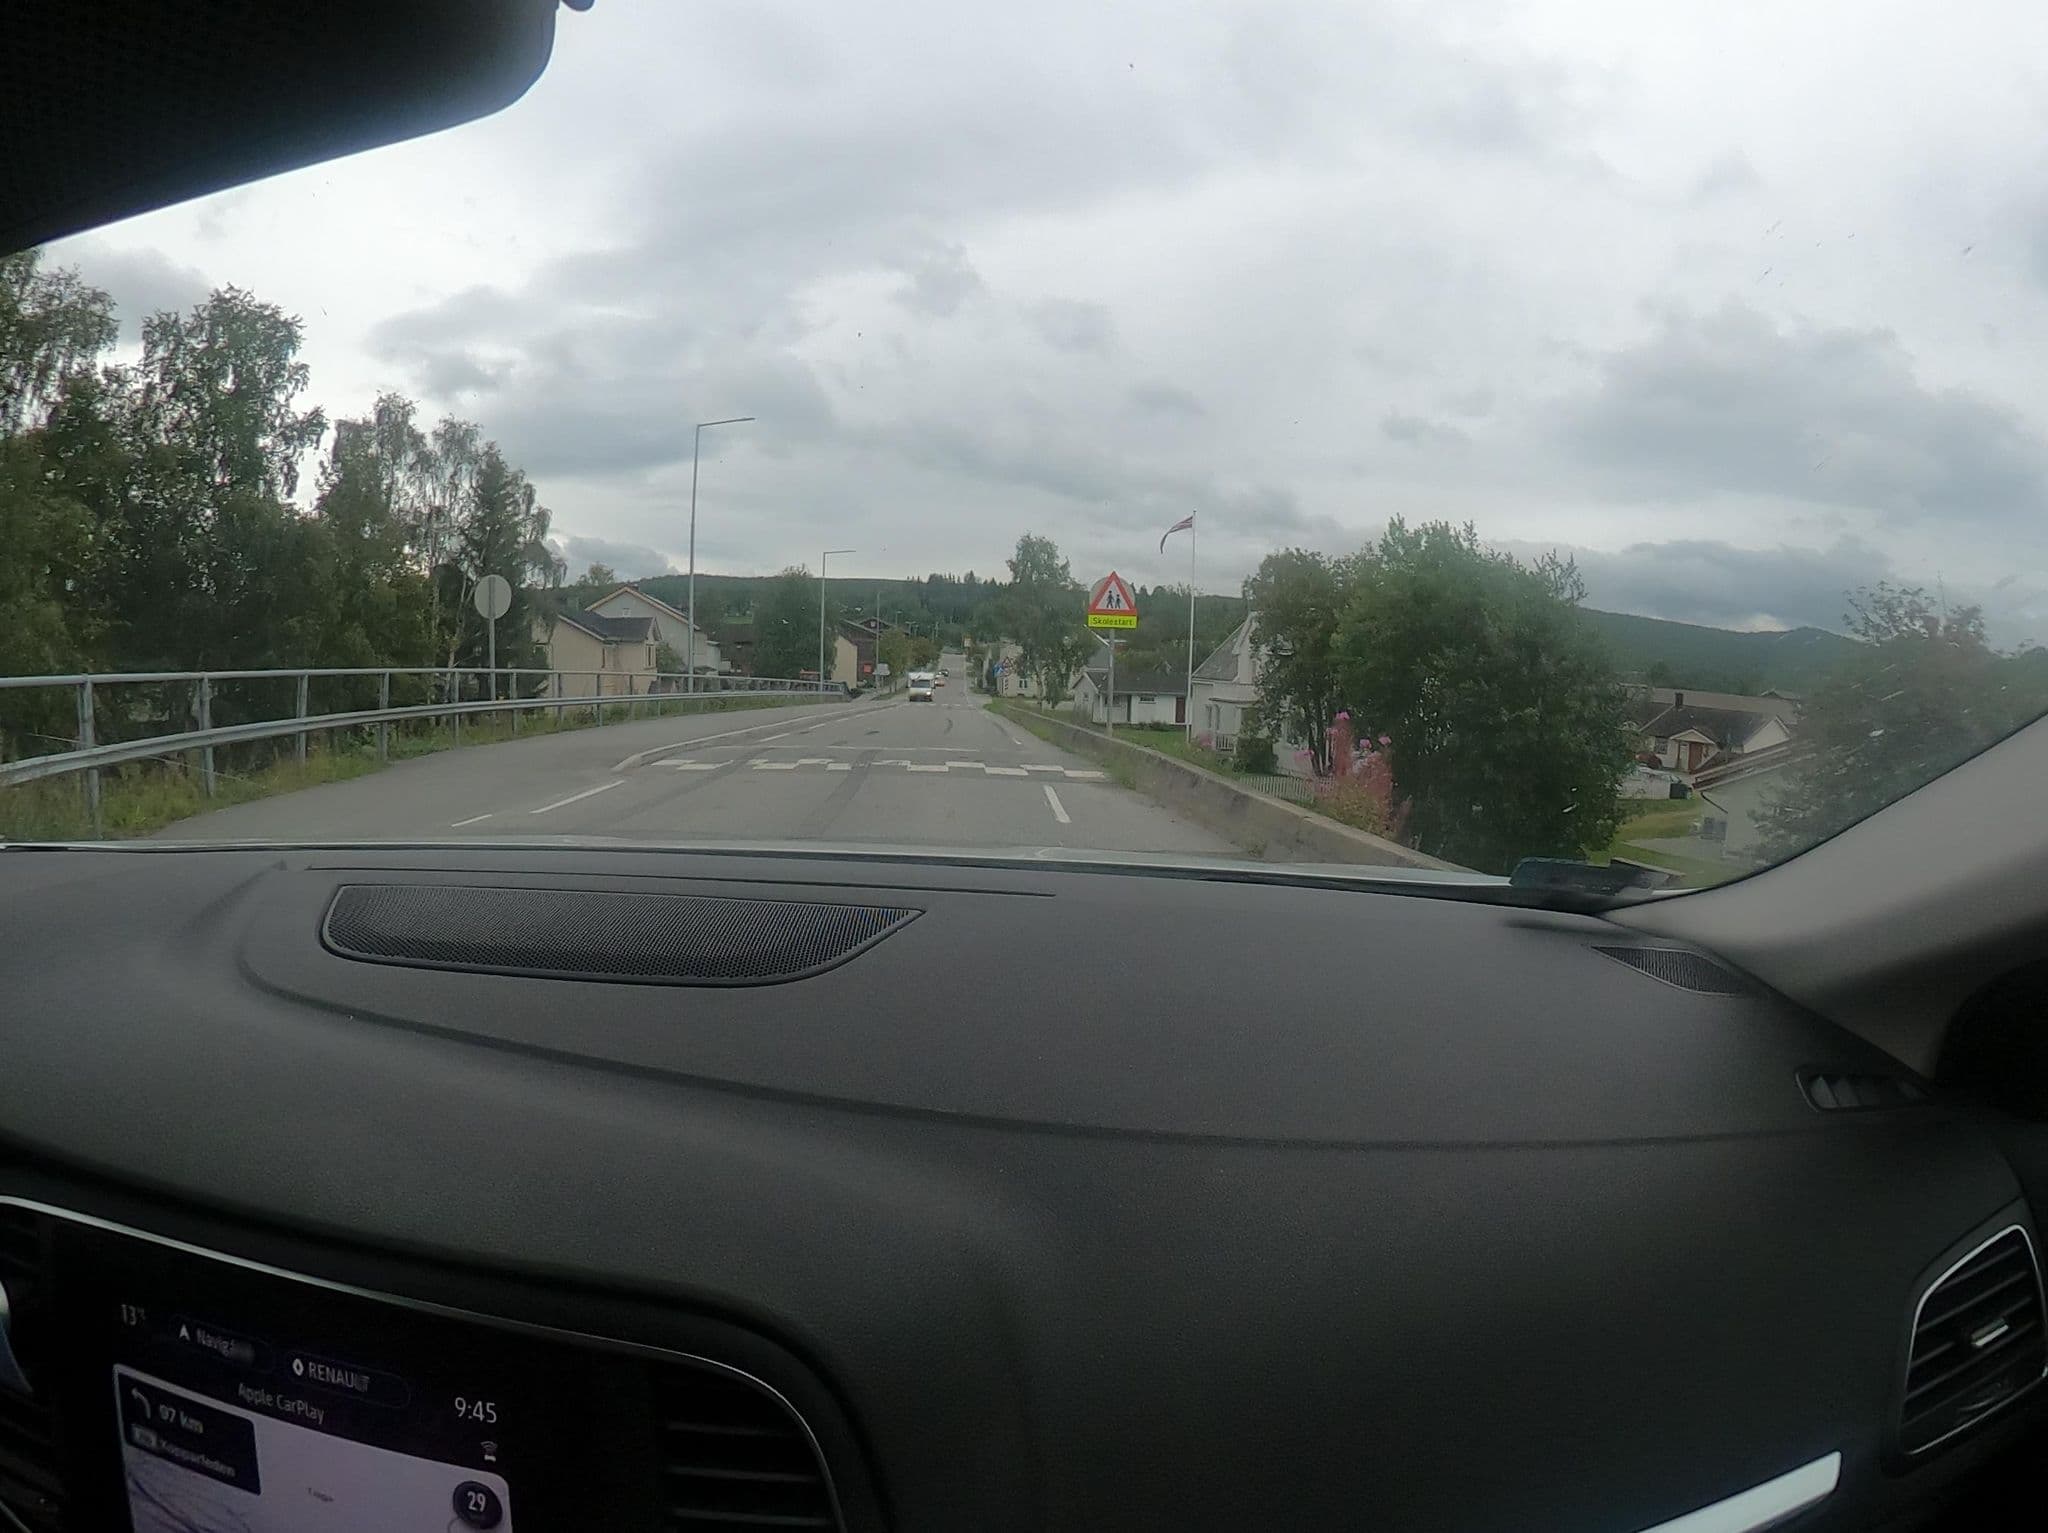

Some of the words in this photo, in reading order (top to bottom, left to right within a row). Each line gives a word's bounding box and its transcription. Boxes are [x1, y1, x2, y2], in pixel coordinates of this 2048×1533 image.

[1092, 616, 1133, 626] Skolestart
[238, 1383, 274, 1407] Apple
[276, 1394, 325, 1424] CarPlay
[454, 1396, 497, 1424] 9:45
[467, 1490, 487, 1512] 29
